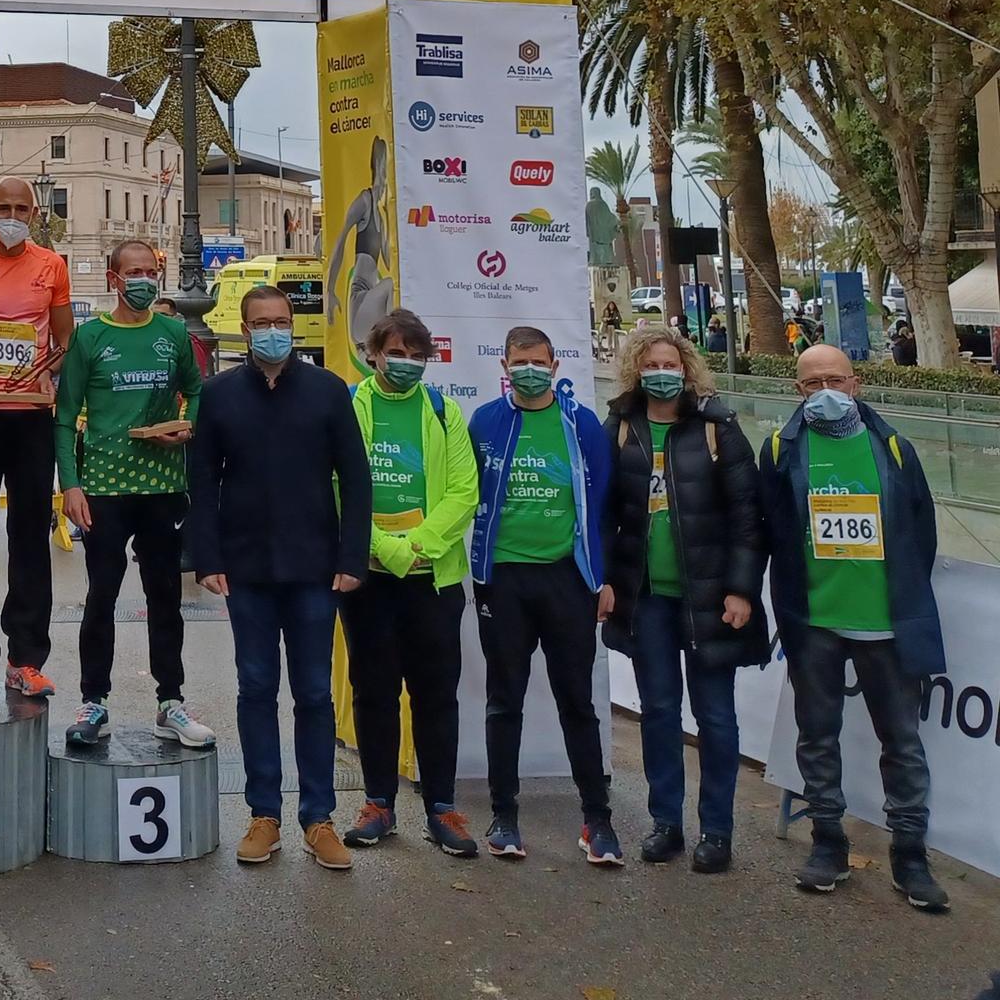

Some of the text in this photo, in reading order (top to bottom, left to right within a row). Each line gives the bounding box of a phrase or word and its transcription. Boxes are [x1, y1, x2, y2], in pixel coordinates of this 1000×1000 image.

[416, 44, 463, 59] Trablisa
[327, 53, 365, 73] Mallorca
[507, 65, 552, 76] ASIMA
[340, 71, 374, 91] marcha
[329, 96, 359, 114] contra
[415, 109, 484, 124] Hi services
[330, 115, 371, 134] el cáncer
[423, 157, 467, 177] BOXI
[513, 165, 552, 182] Quely
[439, 213, 492, 224] motorisa
[510, 222, 571, 234] agromart
[538, 233, 572, 243] balear
[474, 282, 500, 290] Oficial
[502, 283, 512, 291] de
[478, 345, 504, 356] Diari
[449, 383, 477, 399] Força
[370, 441, 401, 453] rcha
[371, 468, 413, 483] áncer
[507, 470, 539, 482] ntra
[512, 483, 560, 498] cáncer
[821, 518, 872, 539] 2186
[128, 787, 169, 854] 3
